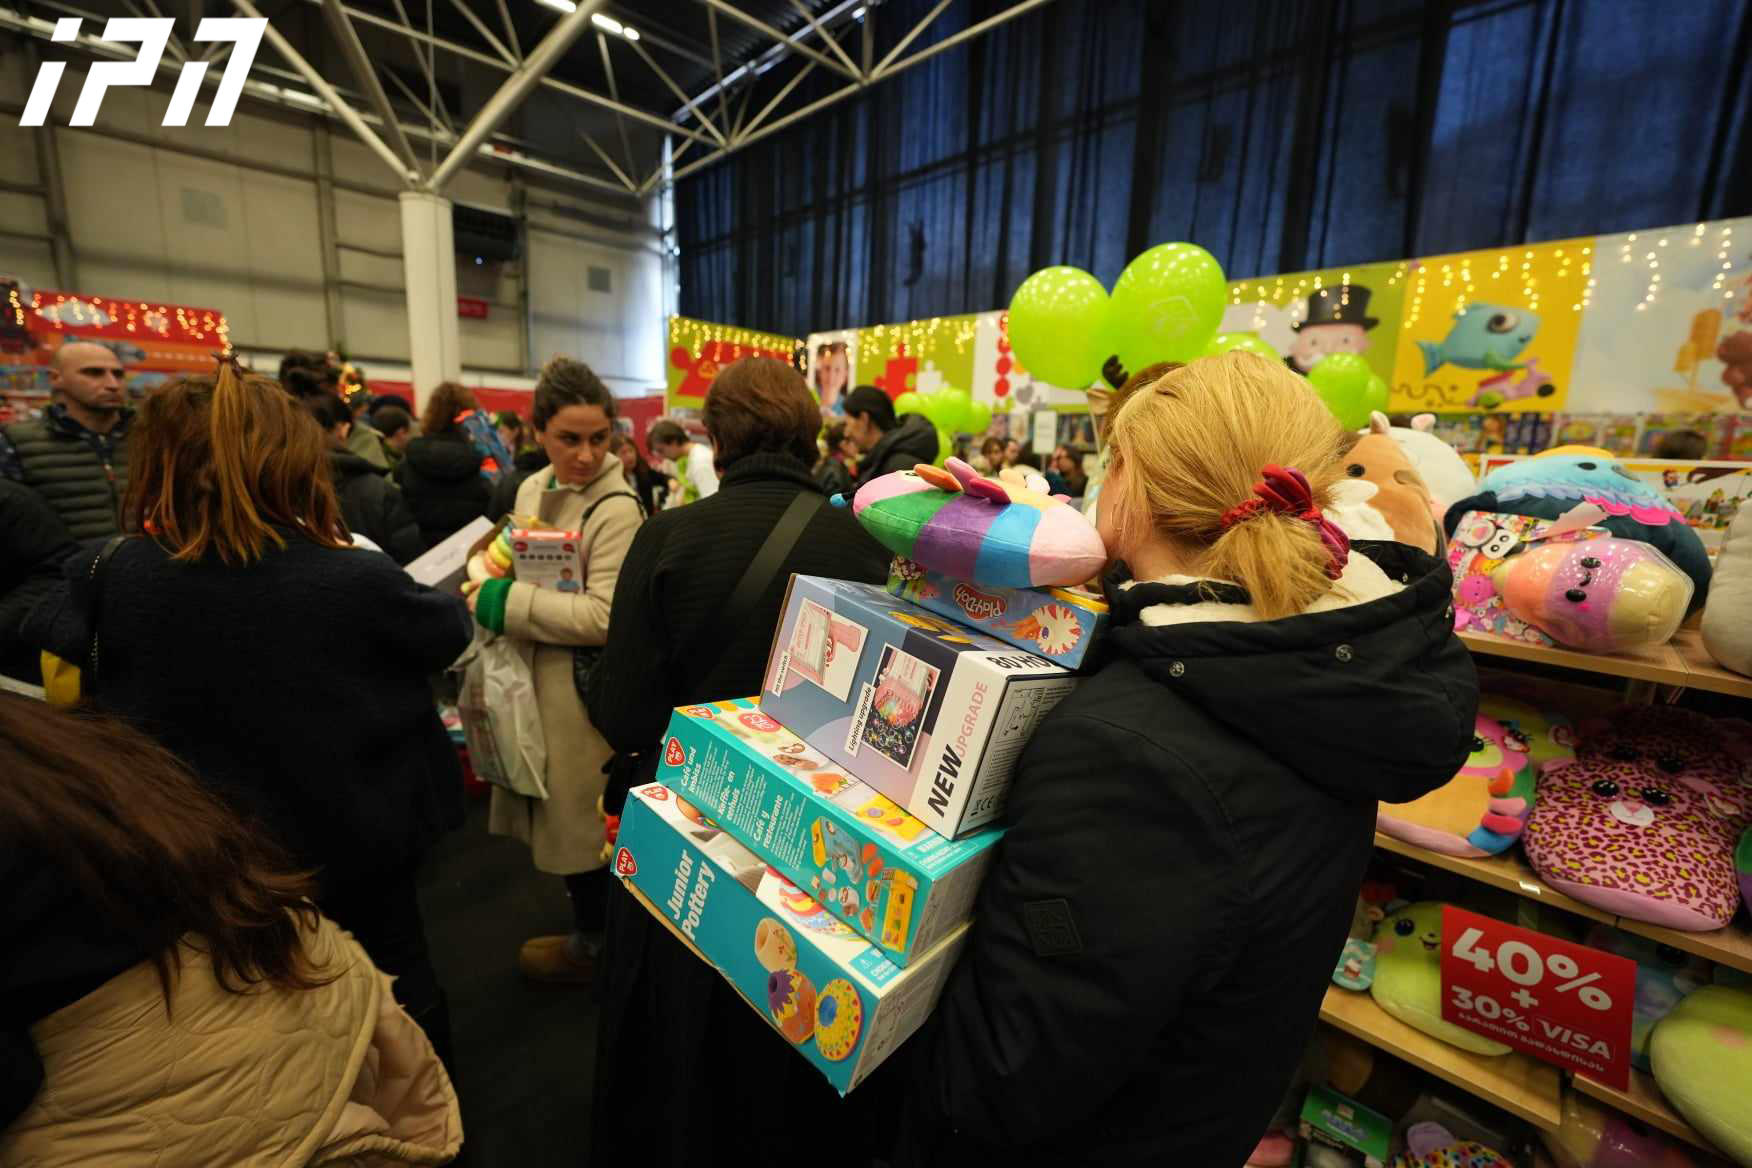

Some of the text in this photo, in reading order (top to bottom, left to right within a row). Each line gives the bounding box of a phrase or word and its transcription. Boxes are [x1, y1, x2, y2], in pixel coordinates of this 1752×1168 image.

[687, 746, 697, 766] und
[848, 687, 873, 752] Lighting upgrade
[927, 743, 963, 817] NEW
[955, 681, 988, 757] UPGRADE
[667, 849, 694, 921] Junior
[681, 860, 716, 942] Pottery
[1452, 927, 1613, 1011] 40%
[1510, 988, 1539, 1009] +
[1451, 984, 1611, 1061] 30% VISA
